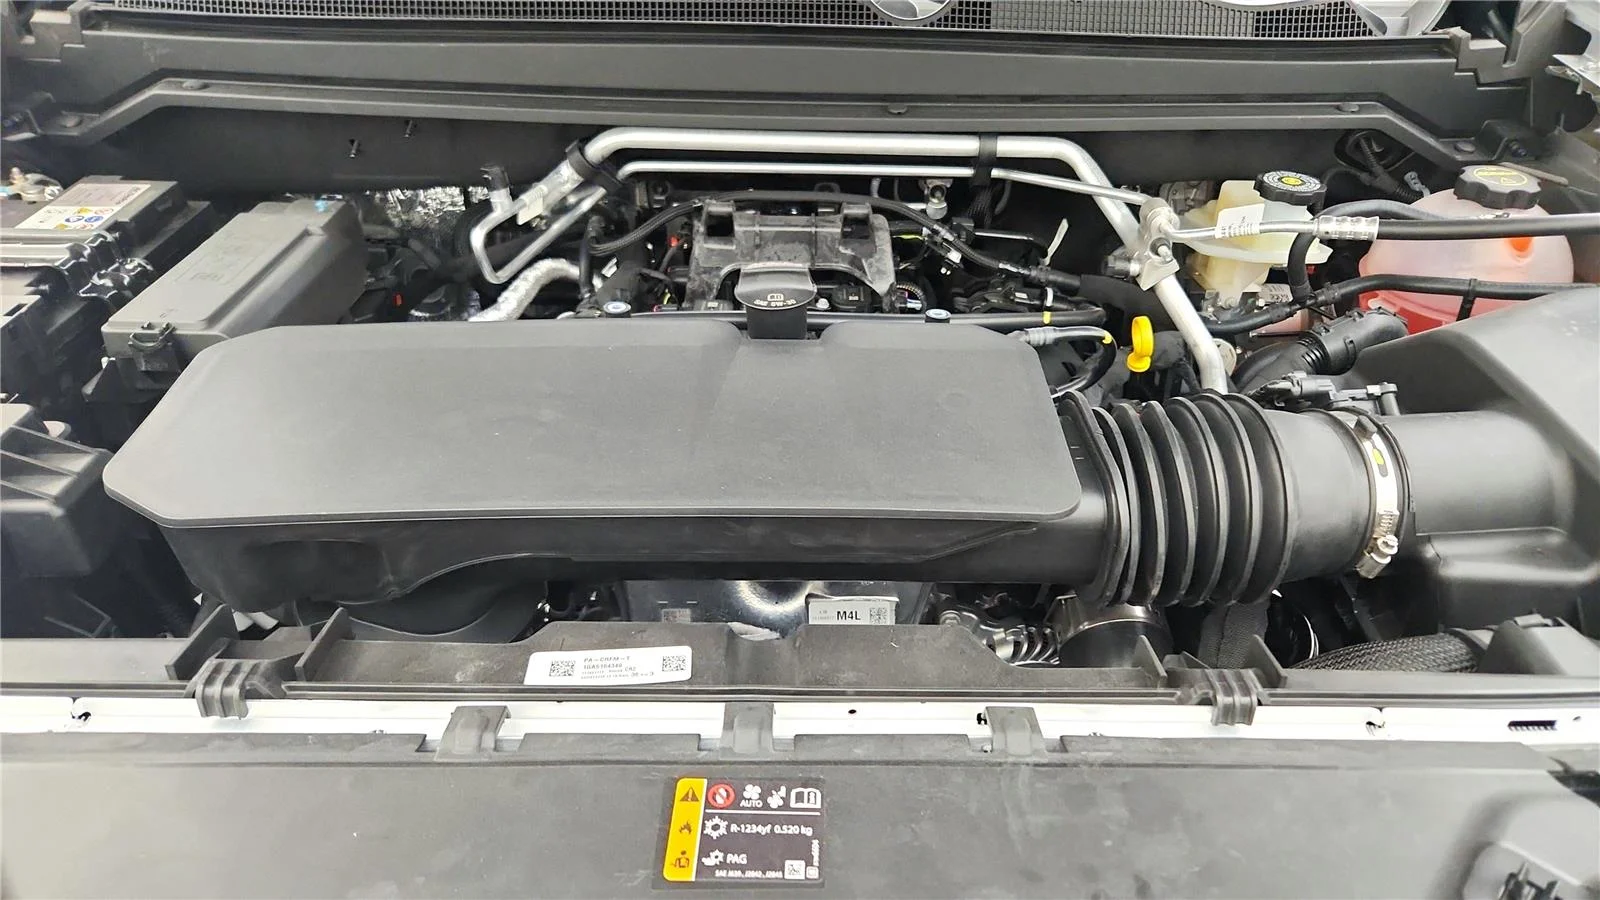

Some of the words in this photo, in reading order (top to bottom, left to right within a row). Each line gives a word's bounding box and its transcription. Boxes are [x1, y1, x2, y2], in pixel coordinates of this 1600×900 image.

[836, 610, 861, 621] M4L
[740, 800, 763, 808] AUTO
[730, 823, 772, 836] R-1234yf
[774, 824, 800, 835] 0.520
[800, 824, 813, 837] kg
[726, 853, 748, 865] PAG
